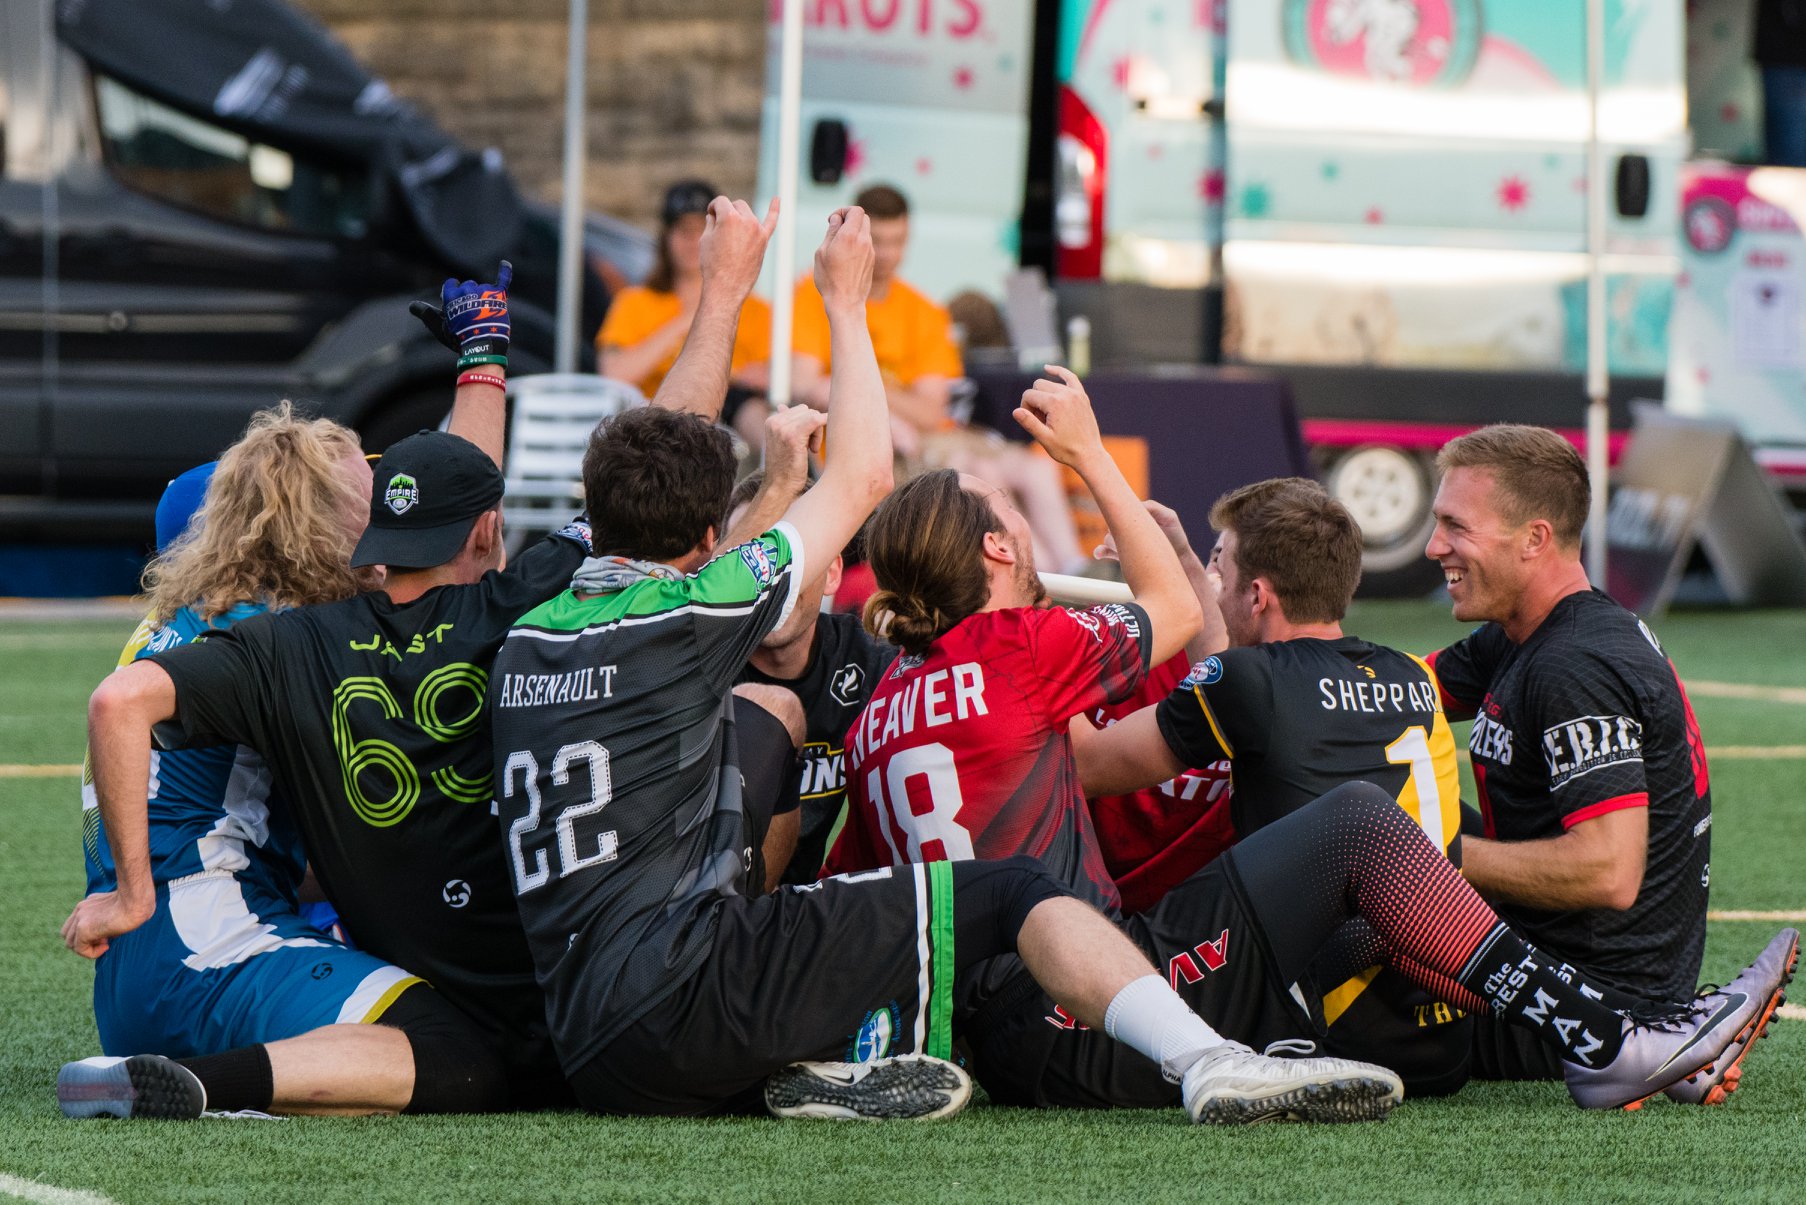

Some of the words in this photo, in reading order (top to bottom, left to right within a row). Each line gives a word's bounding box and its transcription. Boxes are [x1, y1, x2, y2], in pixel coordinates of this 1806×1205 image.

[385, 488, 419, 502] EMPIRE
[500, 665, 618, 708] ARSENAULT
[851, 661, 990, 771] WEAVER
[503, 739, 619, 896] 22
[867, 741, 976, 867] 18
[1483, 961, 1513, 994] The
[1489, 953, 1539, 1014] BEST
